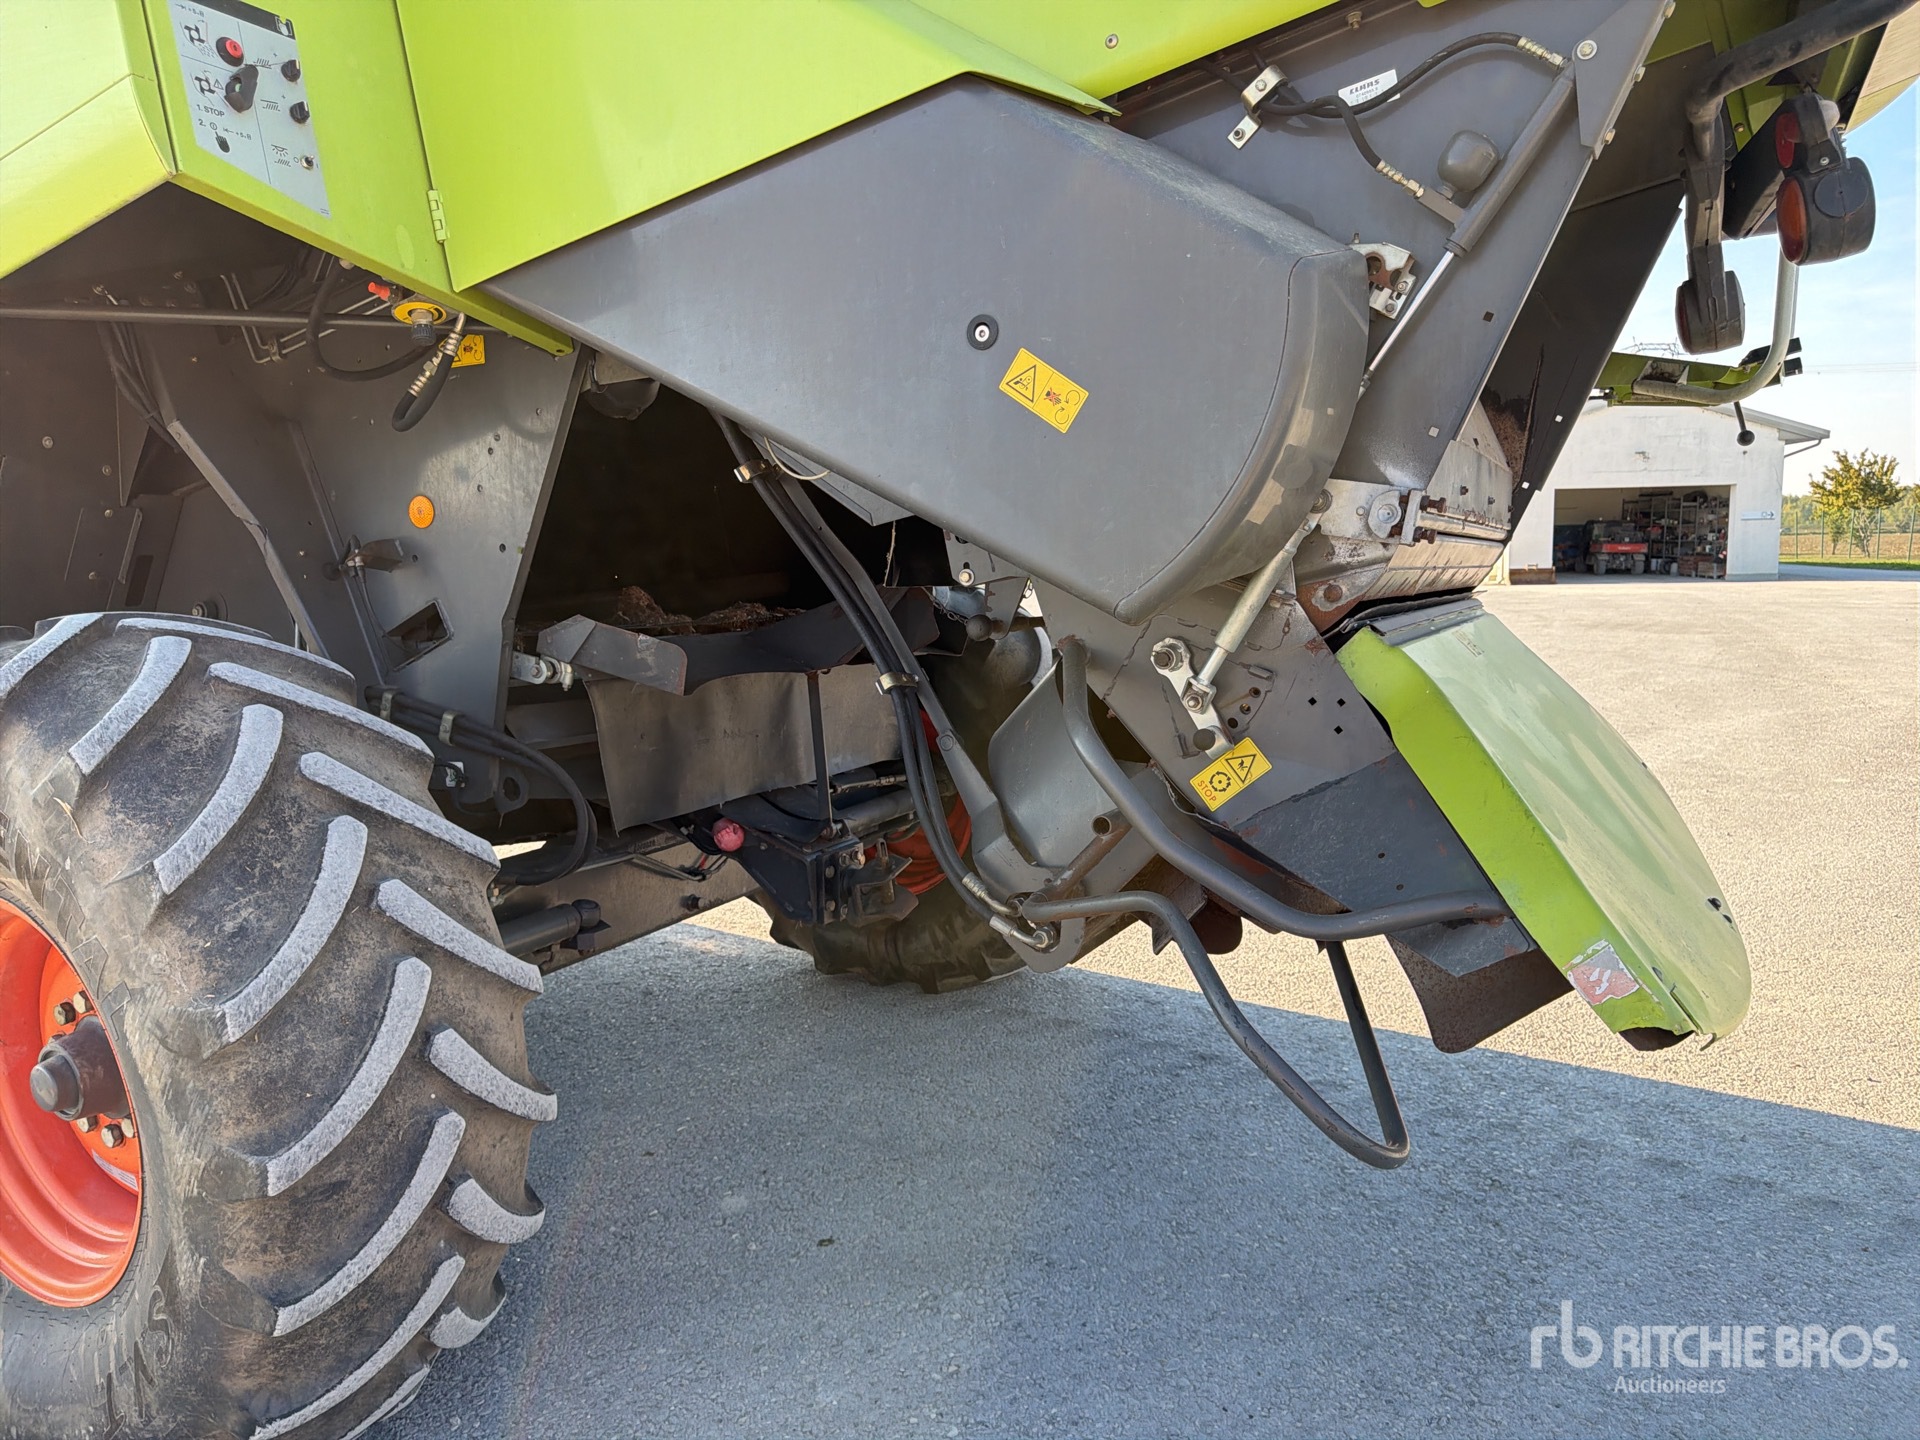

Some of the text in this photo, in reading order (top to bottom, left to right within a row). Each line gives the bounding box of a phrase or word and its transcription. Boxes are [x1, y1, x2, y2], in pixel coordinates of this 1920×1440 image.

[1349, 78, 1380, 95] CLAAS
[204, 105, 225, 118] STOP
[198, 118, 207, 127] 2.
[1197, 779, 1217, 802] STOP
